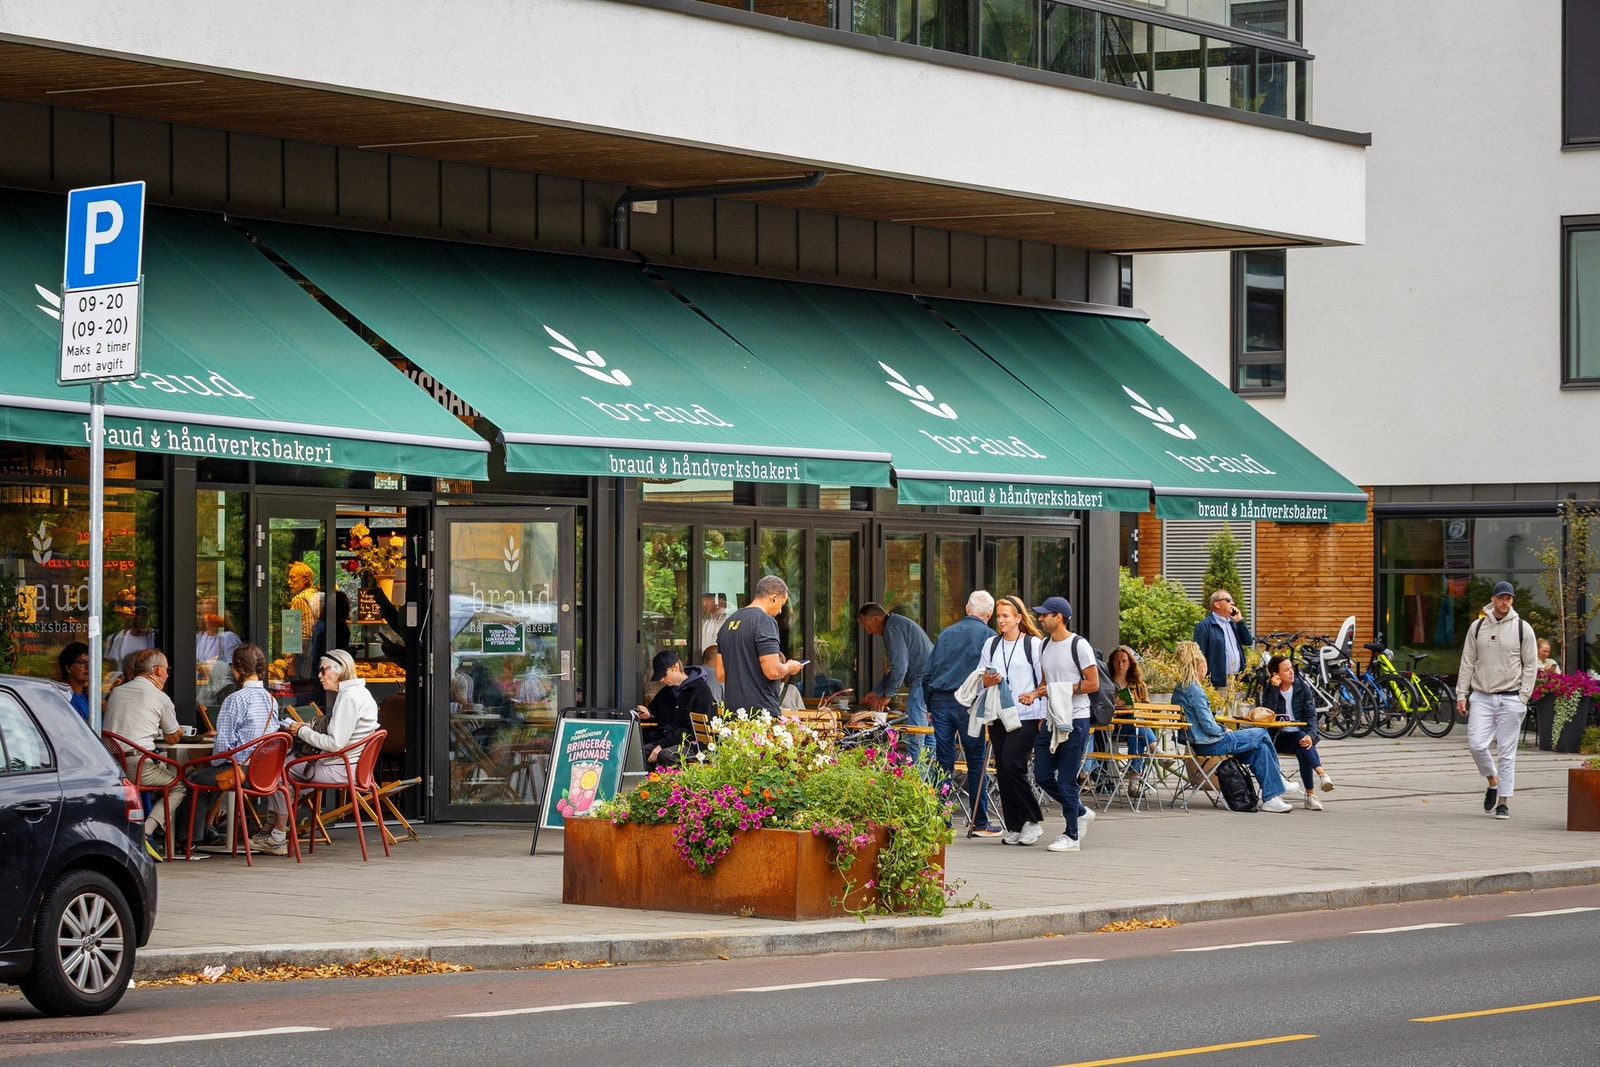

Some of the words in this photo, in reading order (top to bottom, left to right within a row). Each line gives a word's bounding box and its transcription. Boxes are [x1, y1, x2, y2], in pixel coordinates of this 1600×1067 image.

[84, 199, 124, 275] P
[79, 293, 123, 313] 09-20
[72, 316, 128, 340] (09-20)
[66, 344, 91, 356] Maks
[96, 343, 102, 354] 2
[107, 341, 131, 353] timer
[73, 362, 91, 373] mot
[96, 358, 123, 373] avgift
[111, 370, 255, 400] raud
[581, 396, 734, 428] braud
[166, 426, 334, 463] håndverksbakeri
[919, 429, 1047, 459] braud
[609, 454, 654, 476] braud
[672, 454, 801, 480] håndverksbakeri
[1165, 450, 1276, 475] braud
[948, 485, 986, 504] braud
[999, 486, 1103, 507] håndverksbakeri
[1198, 501, 1229, 518] braud
[1239, 498, 1328, 520] håndverksbakeri
[13, 577, 89, 612] raud
[470, 582, 551, 613] braud
[568, 748, 610, 762] LIMONADE
